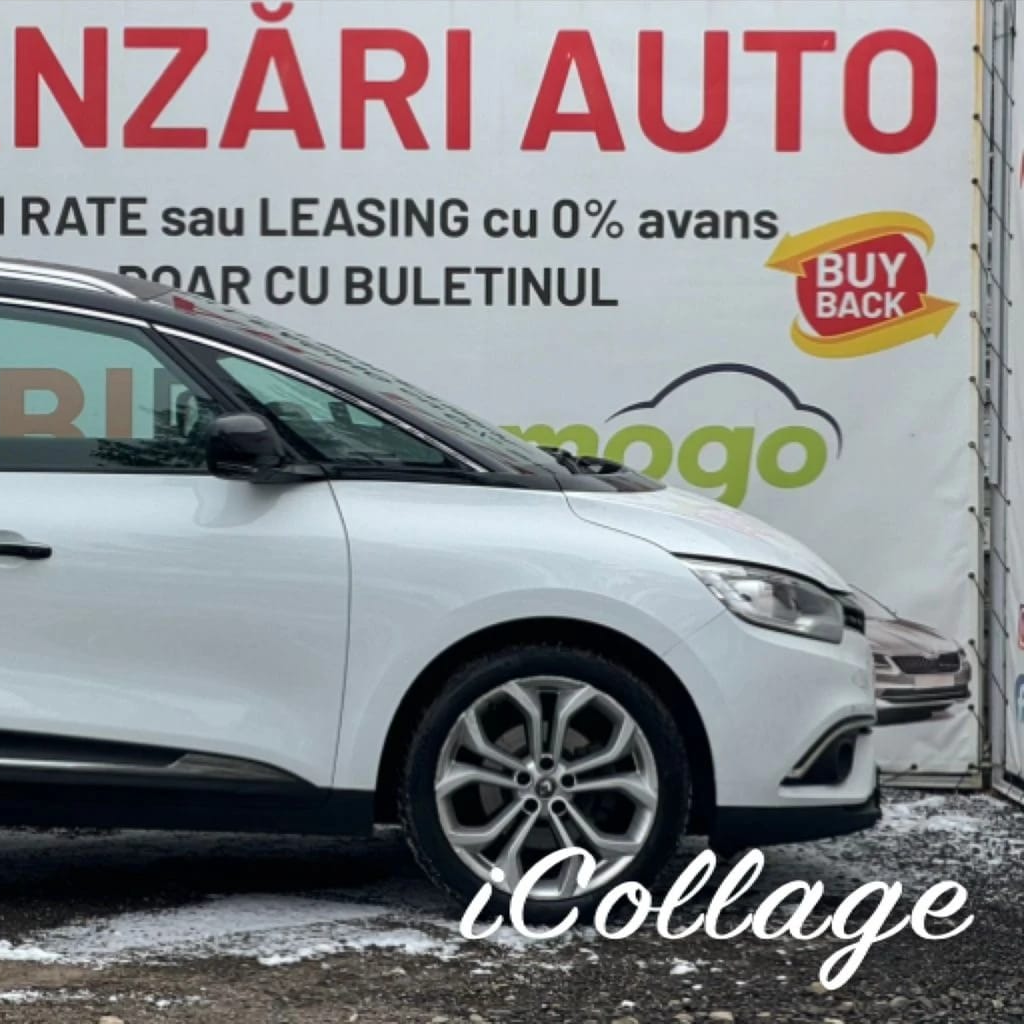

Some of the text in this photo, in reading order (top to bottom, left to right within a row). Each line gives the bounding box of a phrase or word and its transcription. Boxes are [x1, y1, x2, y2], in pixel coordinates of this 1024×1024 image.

[521, 29, 938, 154] AUTO
[21, 196, 148, 237] RATE
[161, 207, 244, 237] sau
[260, 197, 469, 239] LEASING
[483, 208, 538, 239] cu
[552, 199, 624, 239] 0%
[638, 209, 779, 240] avans
[265, 265, 329, 306] CU
[344, 265, 619, 307] BULETINUL
[817, 252, 906, 288] BUY
[817, 291, 905, 318] BACK
